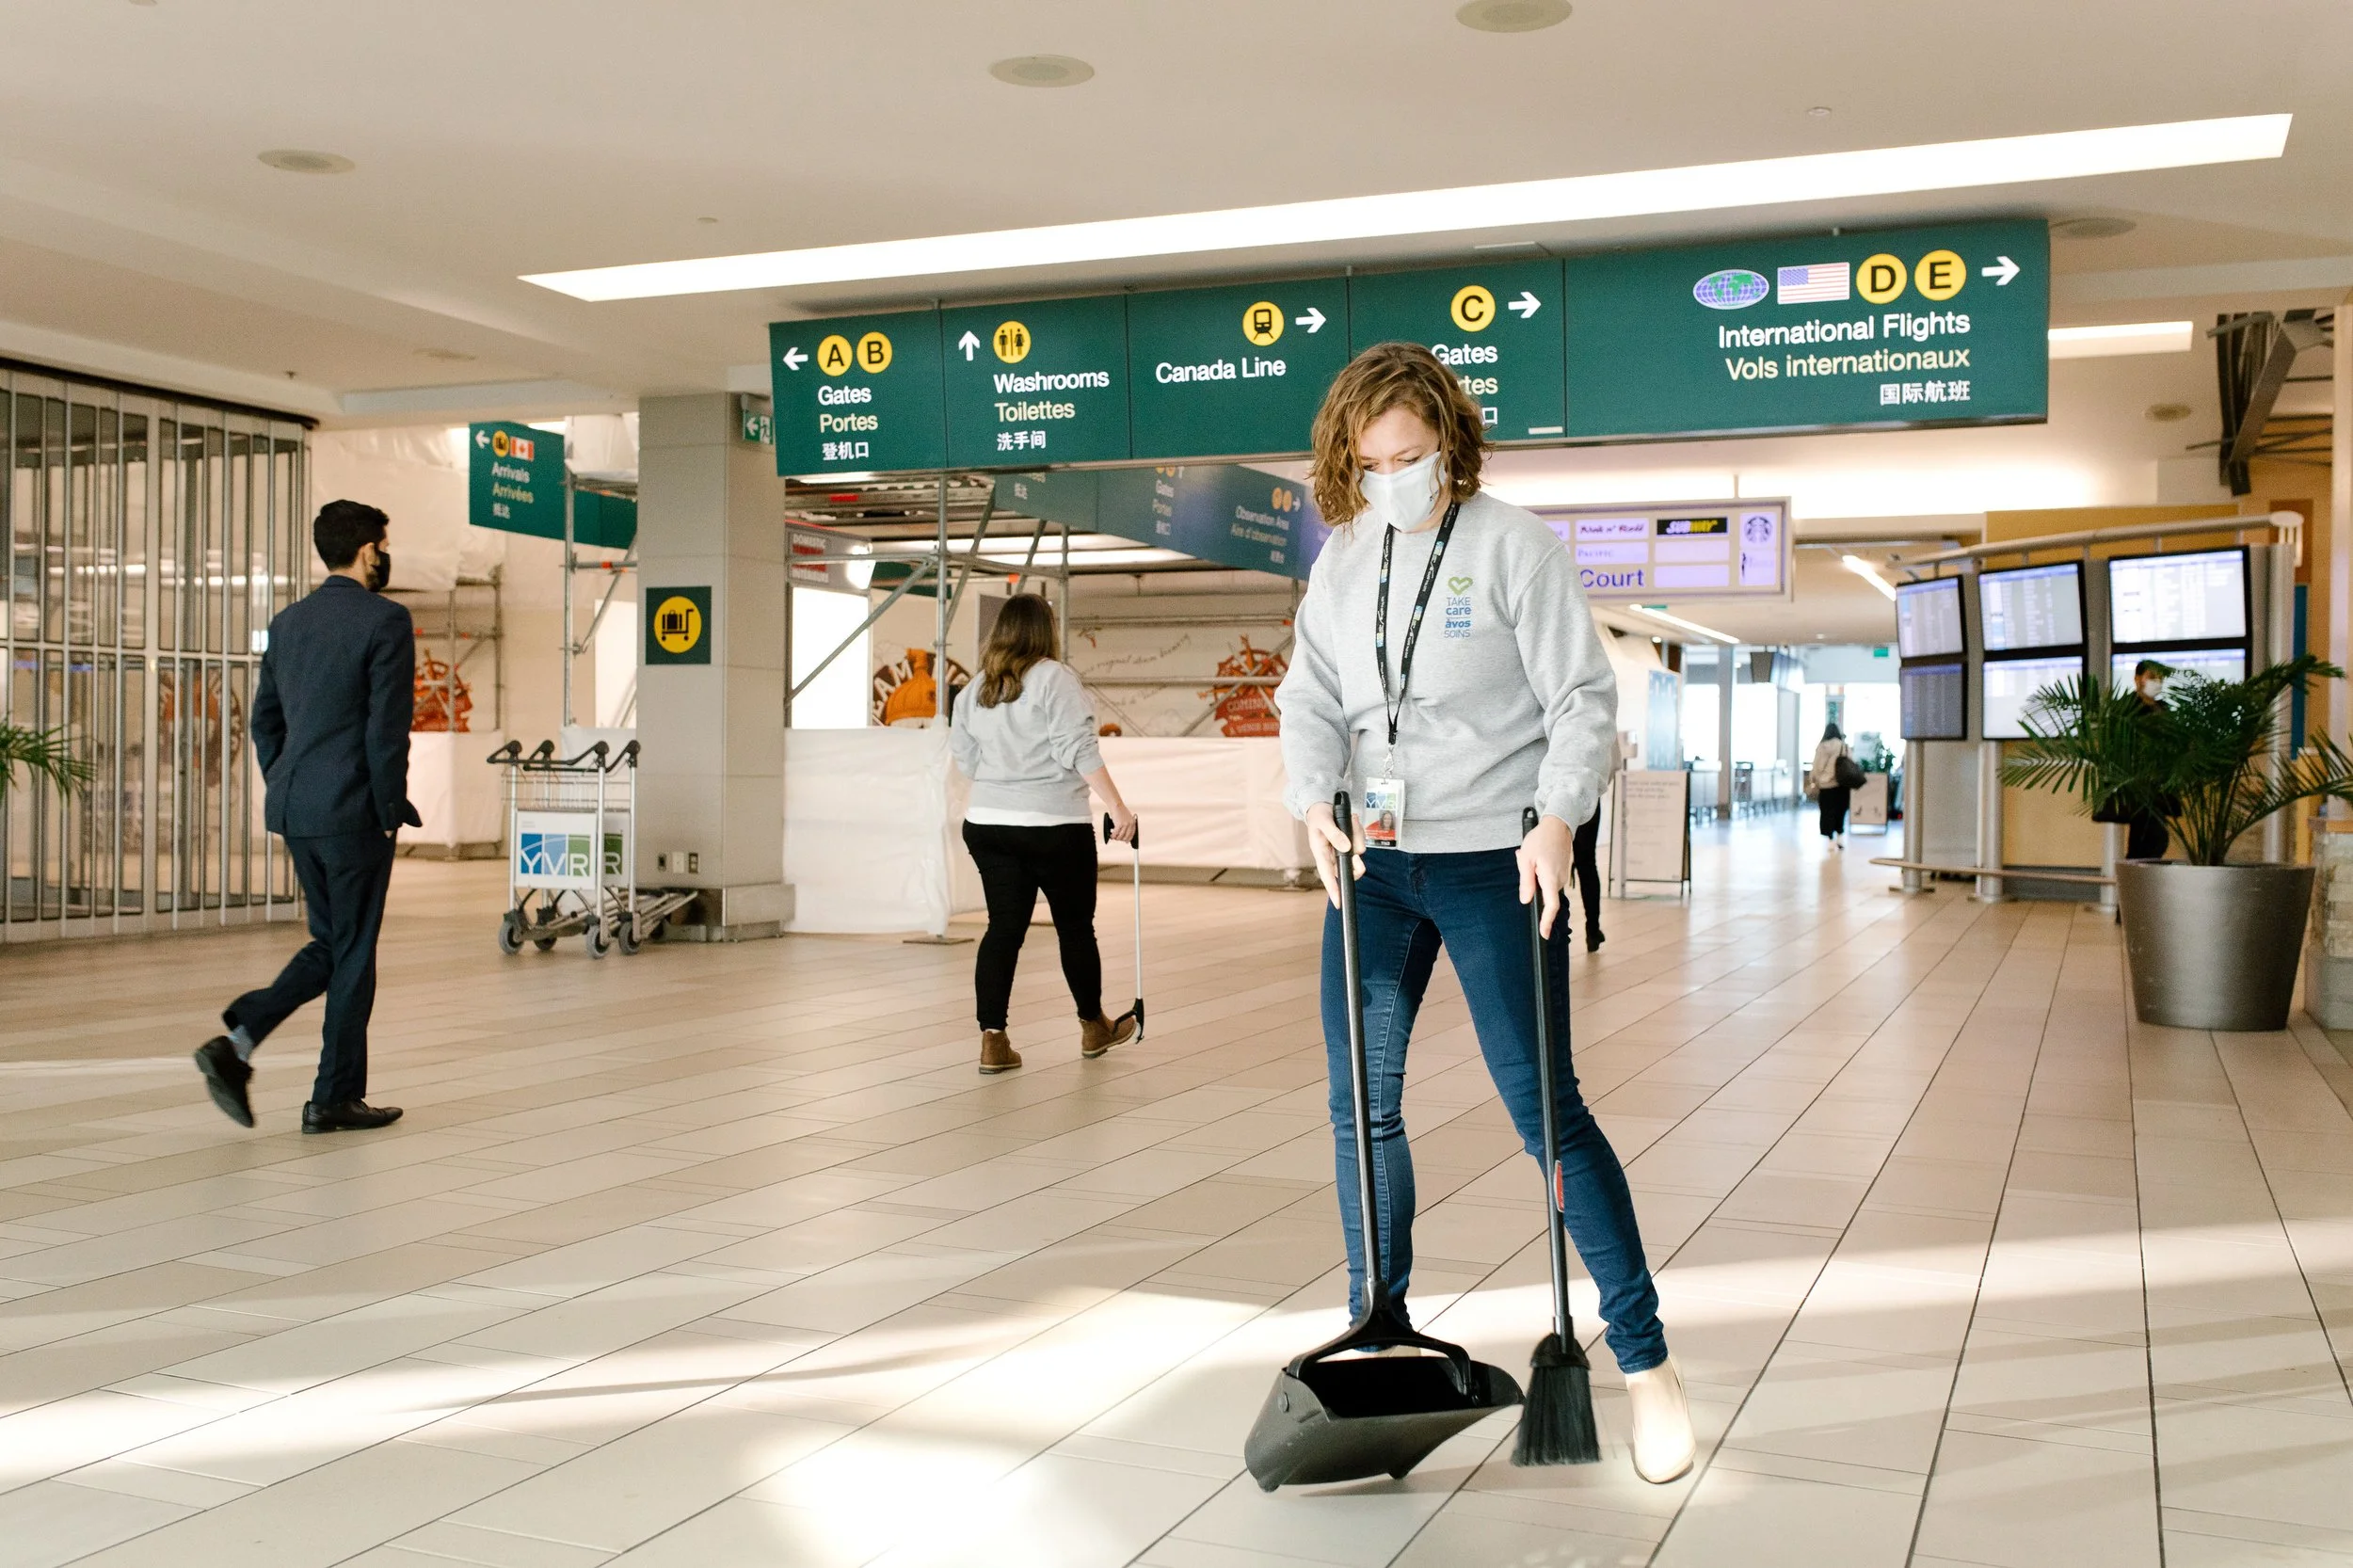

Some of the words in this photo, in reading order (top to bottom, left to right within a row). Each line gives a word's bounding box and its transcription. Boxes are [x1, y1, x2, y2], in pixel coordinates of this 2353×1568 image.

[1871, 265, 1897, 293] D
[1929, 261, 1952, 289] E
[1461, 296, 1484, 322] C
[1719, 315, 1875, 349] International
[1883, 311, 1971, 342] Flights
[826, 344, 844, 367] A
[866, 340, 884, 364] B
[1432, 344, 1498, 365] Gates
[1725, 357, 1779, 381] Vols
[1786, 348, 1971, 377] internationaux
[1155, 359, 1236, 384] Canada
[1241, 357, 1287, 378] Line
[993, 370, 1110, 394] Washrooms
[1881, 379, 1971, 406] 国际航班
[818, 385, 872, 407] Gates
[994, 400, 1075, 423] Toilettes
[820, 412, 878, 434] Portes
[822, 441, 870, 461] 登机口
[997, 430, 1047, 452] 洗手间
[491, 462, 531, 484] Arrivals
[1666, 520, 1718, 534] SUBWAY
[1580, 568, 1644, 587] Court
[1447, 597, 1471, 606] TAKE
[1444, 630, 1471, 638] SOINS
[520, 851, 590, 877] YVR
